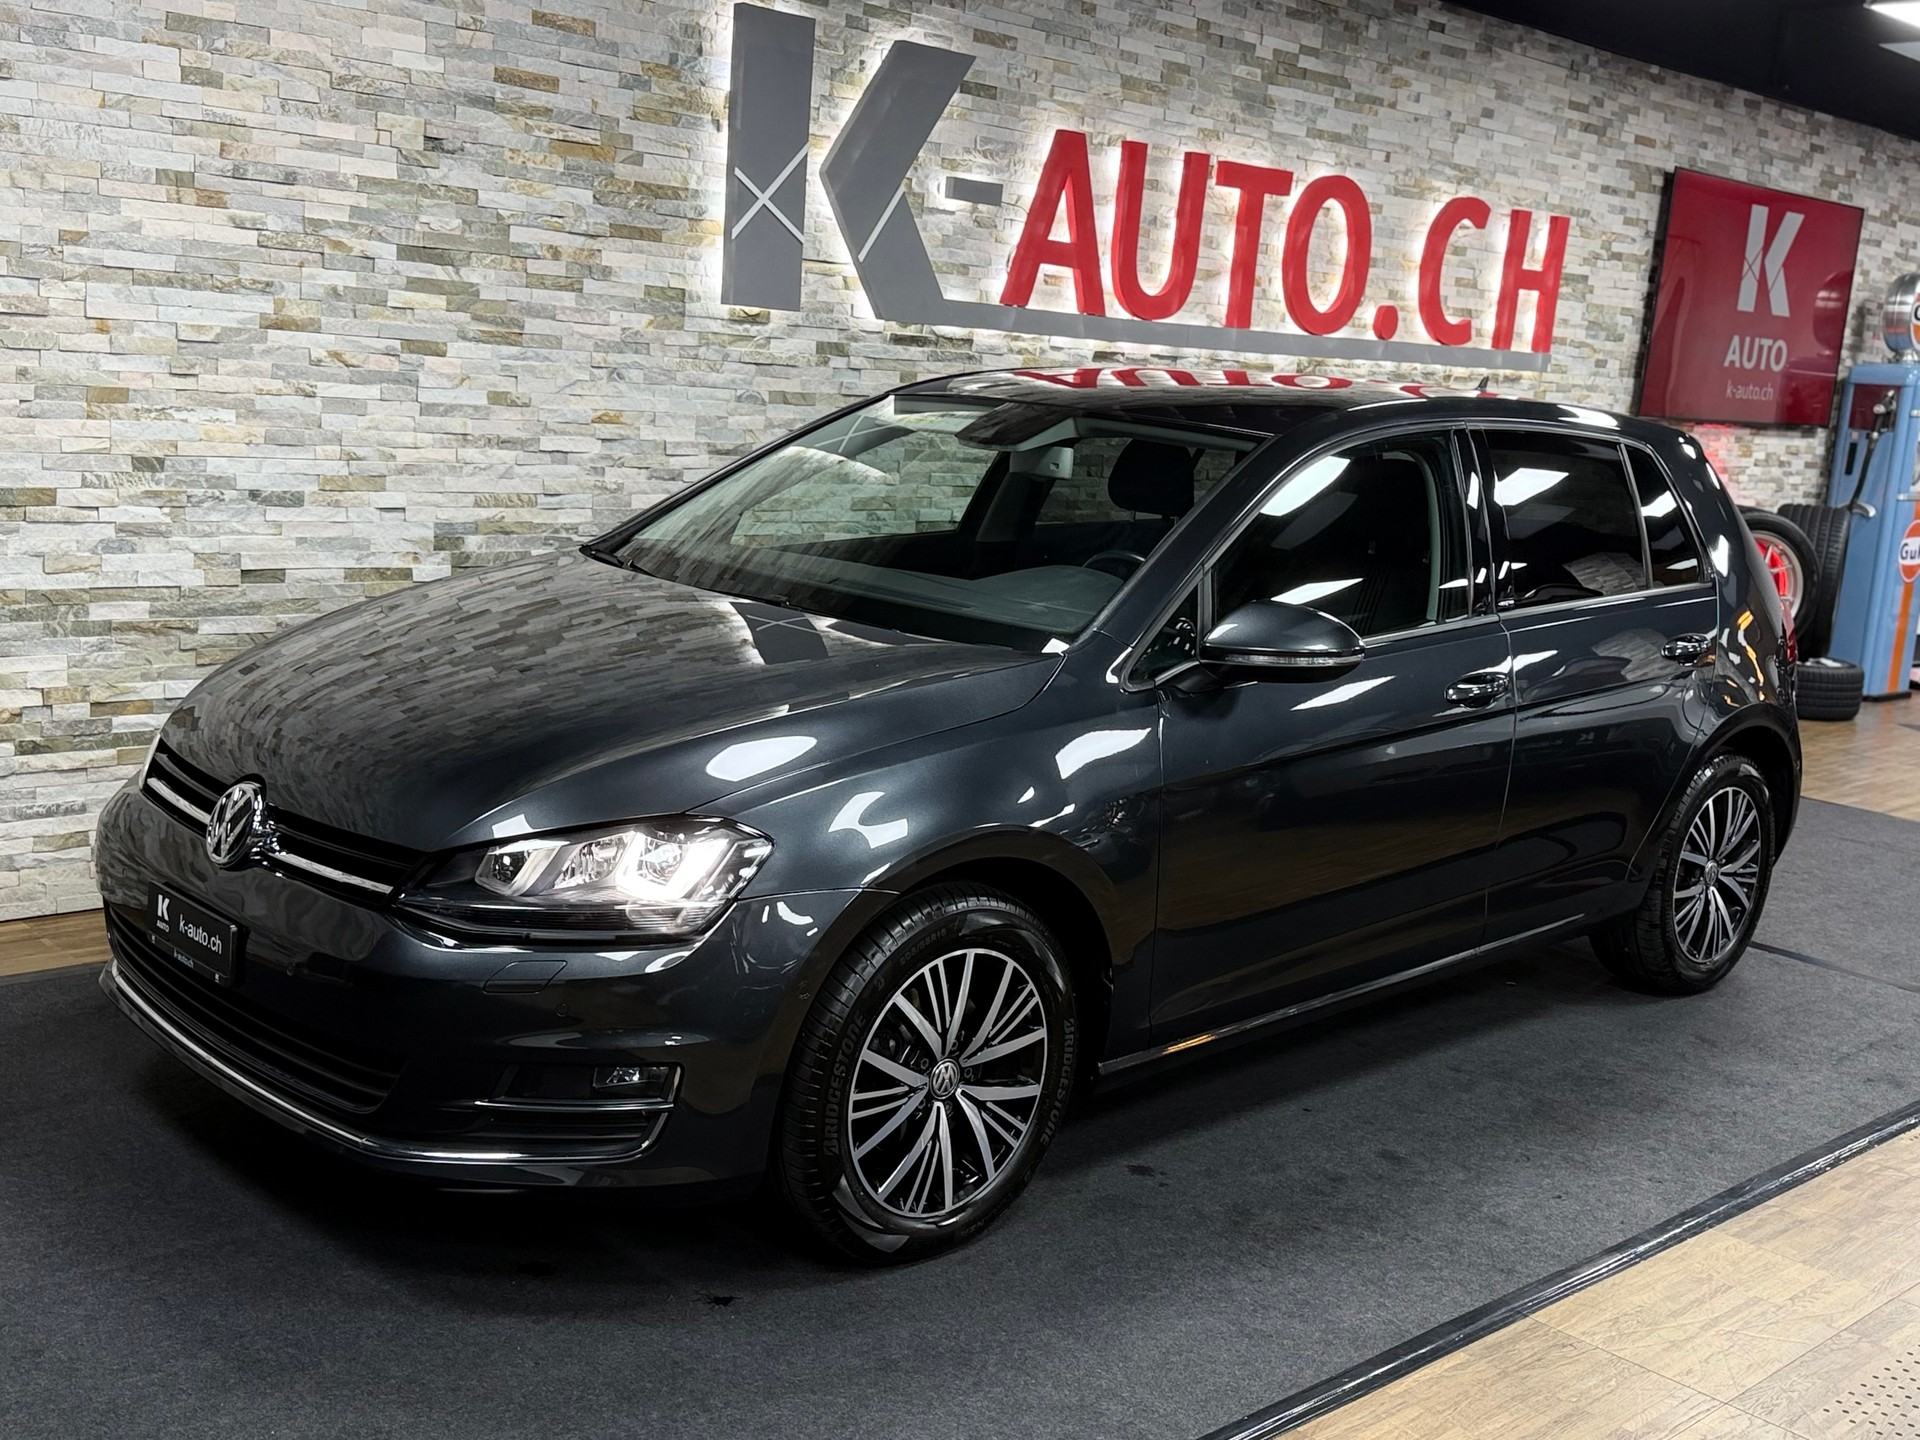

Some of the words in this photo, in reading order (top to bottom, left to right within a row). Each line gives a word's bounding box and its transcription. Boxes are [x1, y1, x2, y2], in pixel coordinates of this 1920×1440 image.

[1737, 203, 1805, 318] K
[1724, 335, 1788, 372] AUTO
[1726, 380, 1773, 401] k-auto.ch
[156, 920, 170, 933] AUTO
[157, 894, 170, 921] K
[179, 913, 222, 955] k-auto.ch
[822, 1010, 868, 1157] BRIDGESTONE
[1040, 1016, 1075, 1146] BRIDGESTONE
